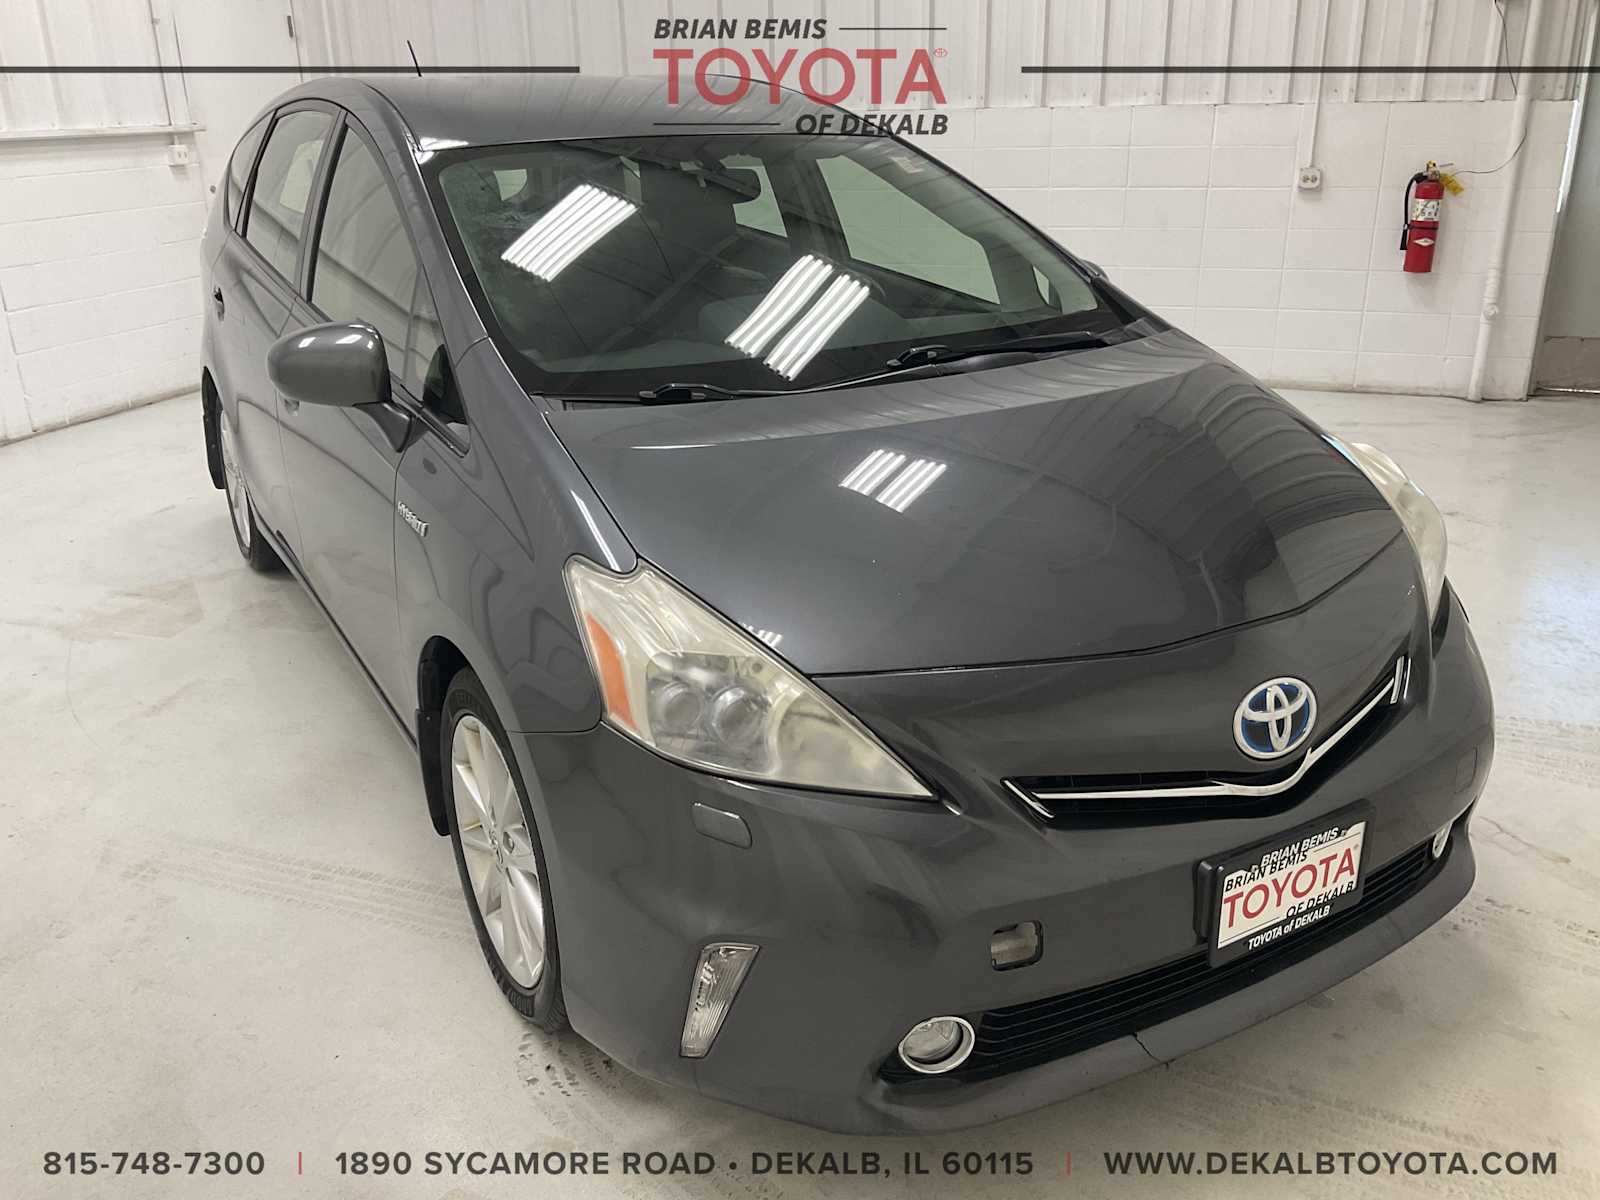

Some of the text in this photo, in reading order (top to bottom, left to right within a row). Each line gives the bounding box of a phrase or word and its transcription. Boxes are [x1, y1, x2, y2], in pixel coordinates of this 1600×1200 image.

[1261, 827, 1339, 867] BRIAN BEMIS
[1223, 847, 1355, 928] TOYOTA
[1225, 851, 1308, 892] BRIAN BEMIS
[1307, 881, 1354, 910] DEKALB
[1249, 905, 1330, 950] TOYOTA of DEKALB
